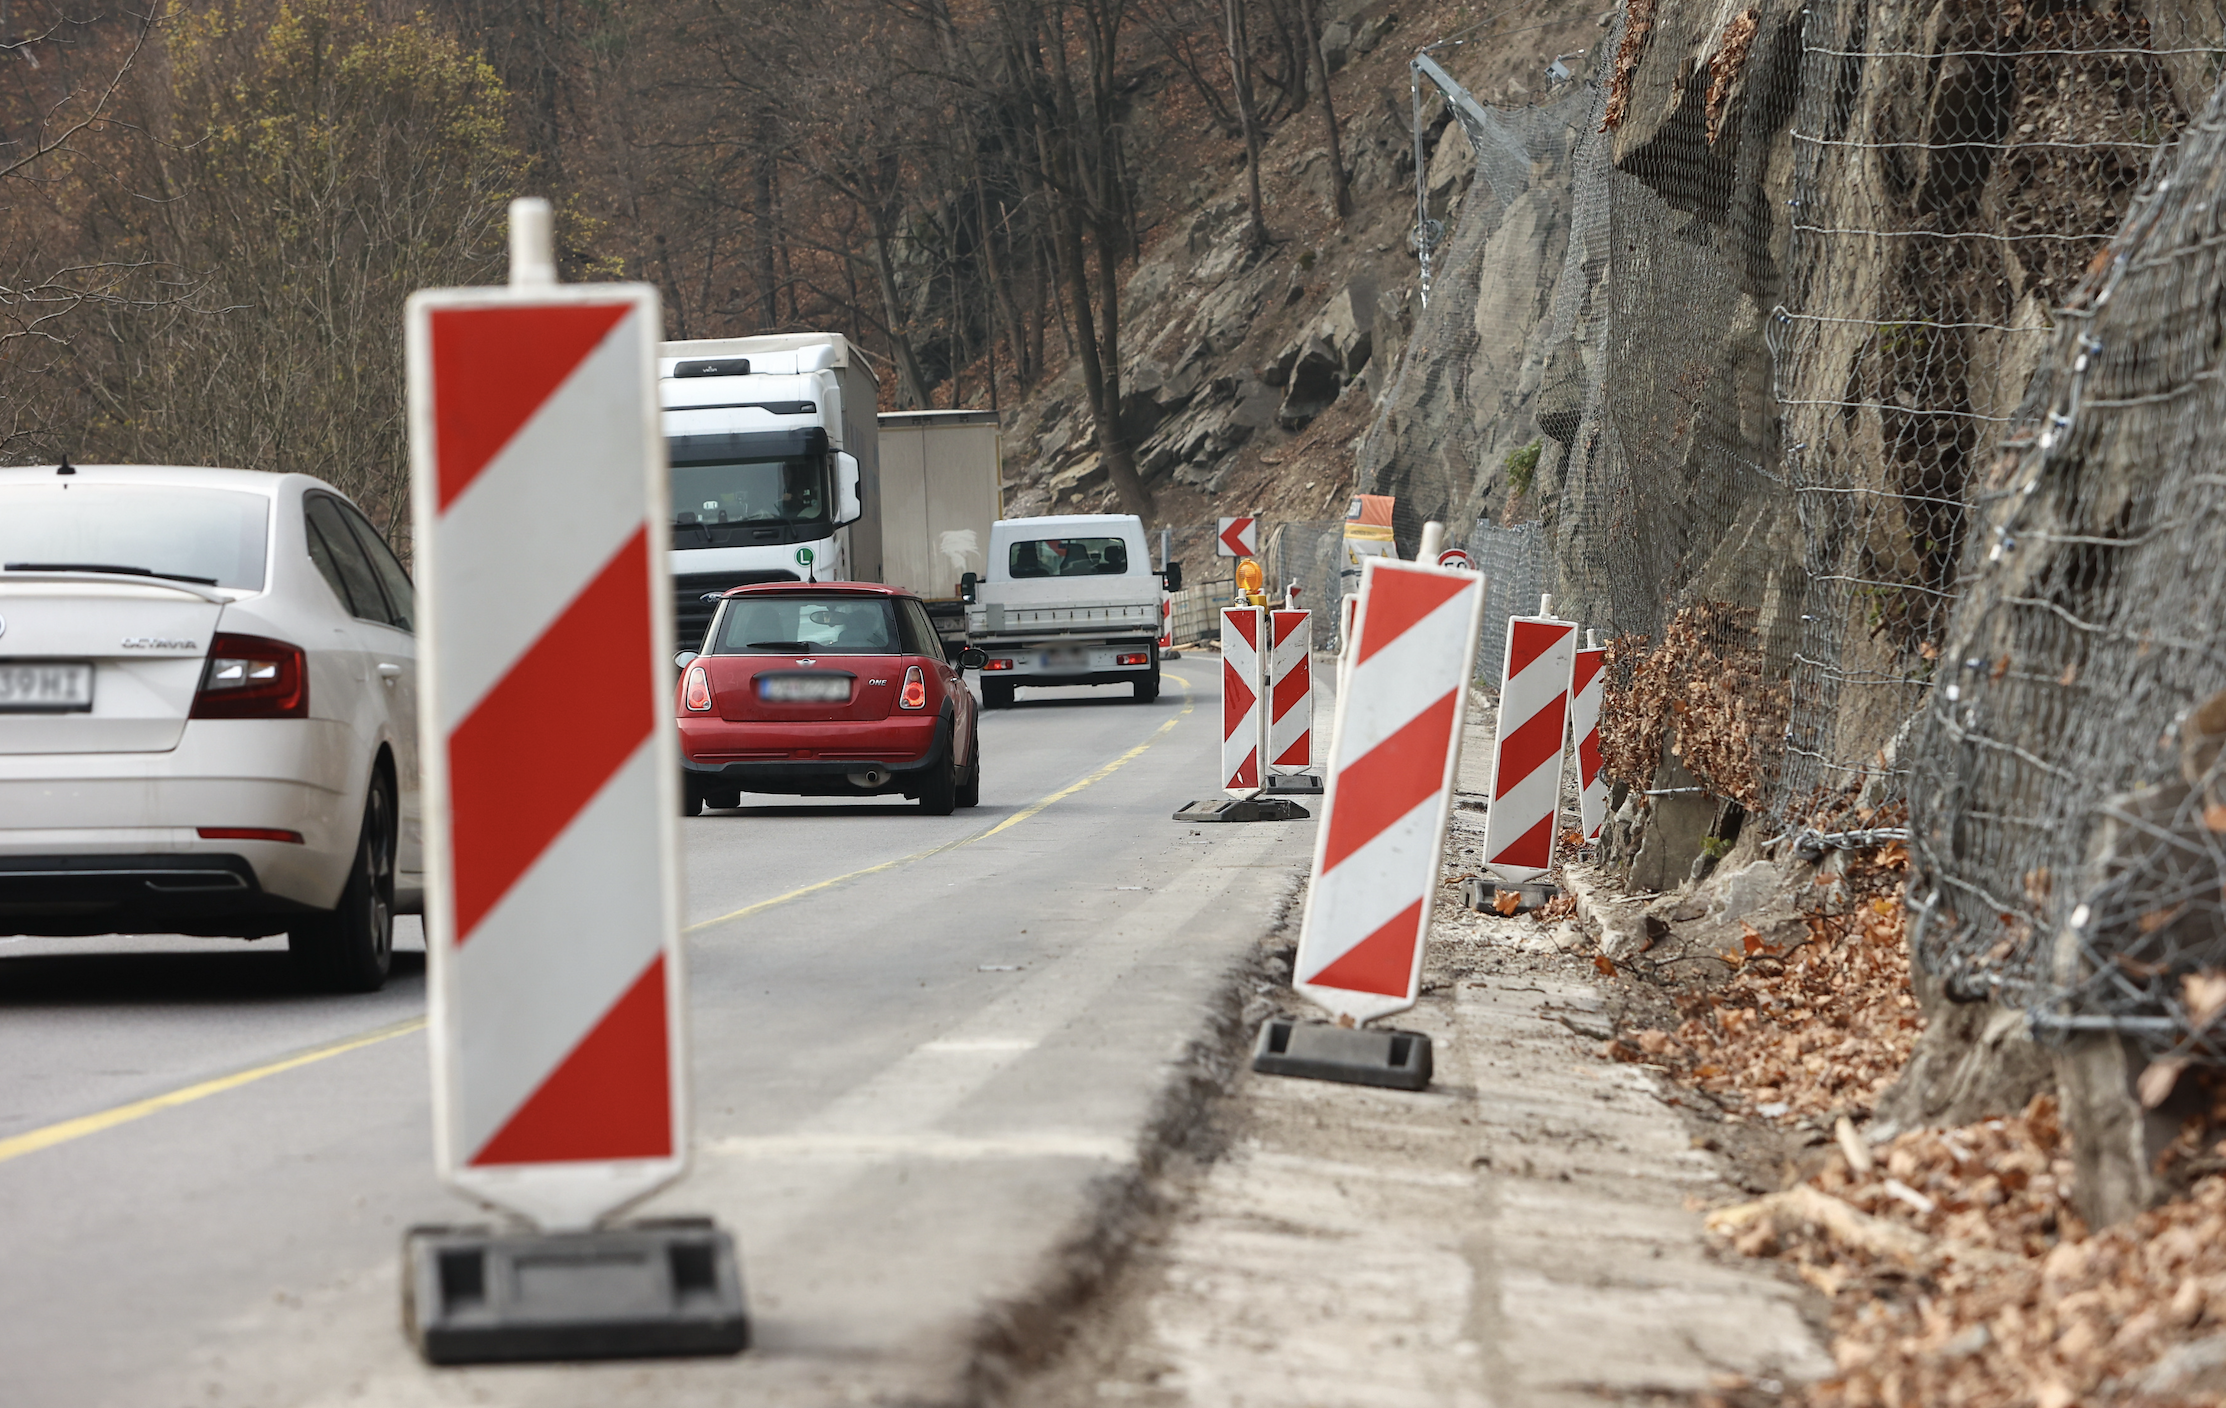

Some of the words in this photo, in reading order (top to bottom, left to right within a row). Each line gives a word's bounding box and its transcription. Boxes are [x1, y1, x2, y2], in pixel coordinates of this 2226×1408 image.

[800, 550, 810, 564] L
[121, 637, 197, 649] OCTAVIA
[868, 678, 888, 687] ONE
